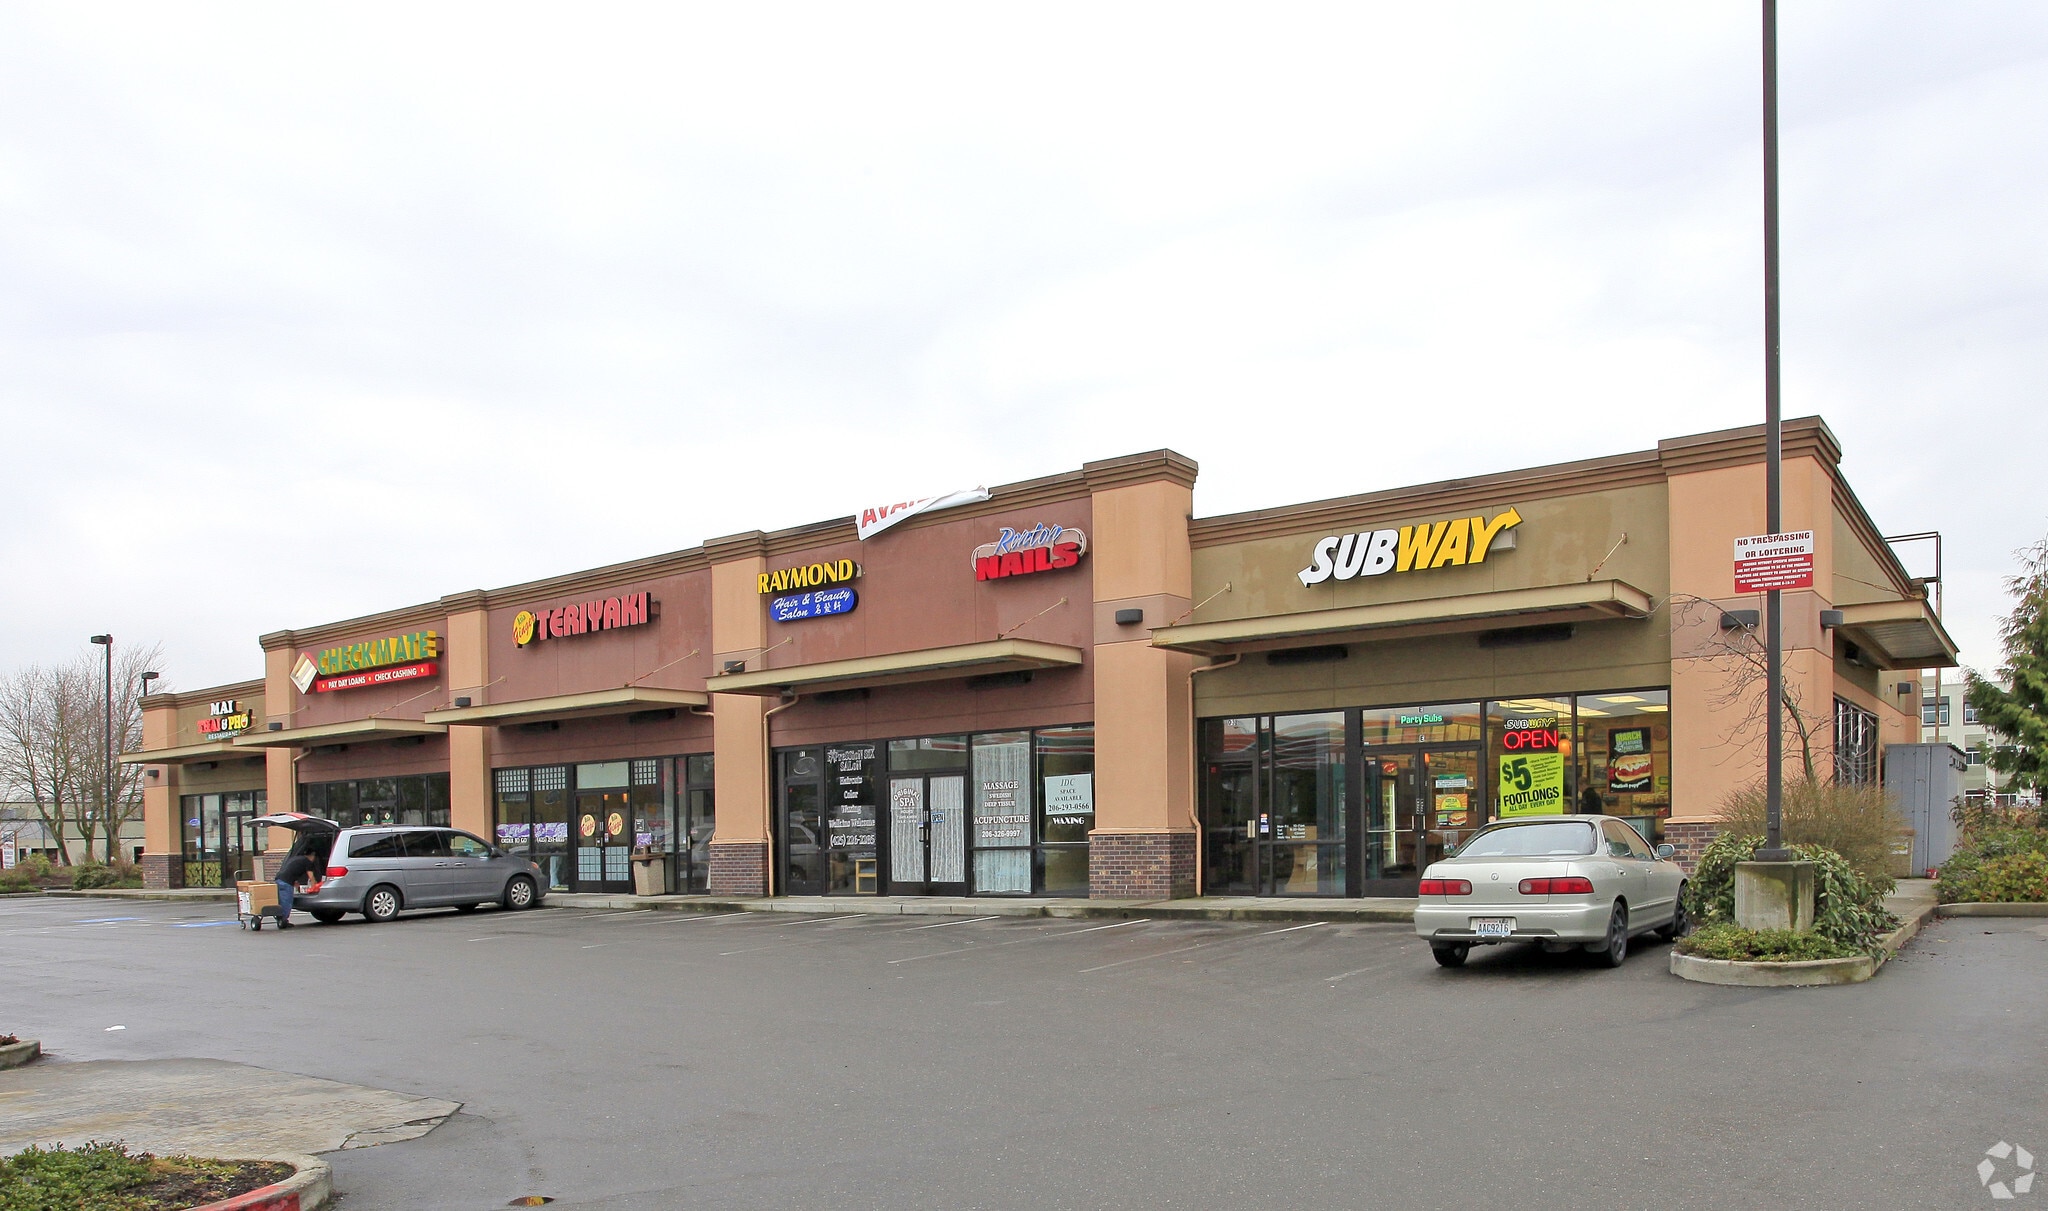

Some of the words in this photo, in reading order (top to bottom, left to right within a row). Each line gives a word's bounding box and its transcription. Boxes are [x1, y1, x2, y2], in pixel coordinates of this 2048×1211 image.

[994, 522, 1063, 554] Renton
[1737, 538, 1748, 546] NO
[1751, 532, 1810, 544] TRESPASSING
[1297, 507, 1523, 588] SUBWAY
[1759, 546, 1805, 557] LOITERING
[976, 542, 1079, 582] NAILS
[758, 558, 853, 594] RAYMOND
[774, 598, 798, 610] Hair
[802, 593, 810, 605] &
[814, 590, 851, 603] Beauty
[536, 592, 649, 640] TERIYAKI
[779, 608, 808, 620] Salon
[328, 681, 338, 689] PAY
[348, 676, 366, 686] LOANS
[374, 672, 392, 682] CHECK
[392, 668, 417, 679] CASHING
[210, 700, 234, 716] MAI
[196, 718, 221, 734] THAI
[1400, 714, 1422, 725] Party
[1424, 714, 1443, 722] Subs
[1504, 718, 1555, 729] SUBWAY
[1503, 730, 1558, 750] OPEN
[1615, 731, 1642, 742] MARCH
[1502, 757, 1532, 791] $5
[984, 781, 1019, 790] MASSAGE
[844, 790, 858, 798] Color
[893, 788, 920, 801] ORIGINAL
[1504, 786, 1559, 807] FOOTLONGS
[900, 798, 915, 807] SPA
[1048, 803, 1090, 812] 206-293-0566
[1509, 804, 1518, 812] ALL
[1519, 802, 1528, 810] DAY
[974, 815, 1030, 825] ACUPUNCTURE
[1052, 817, 1084, 825] WAXING
